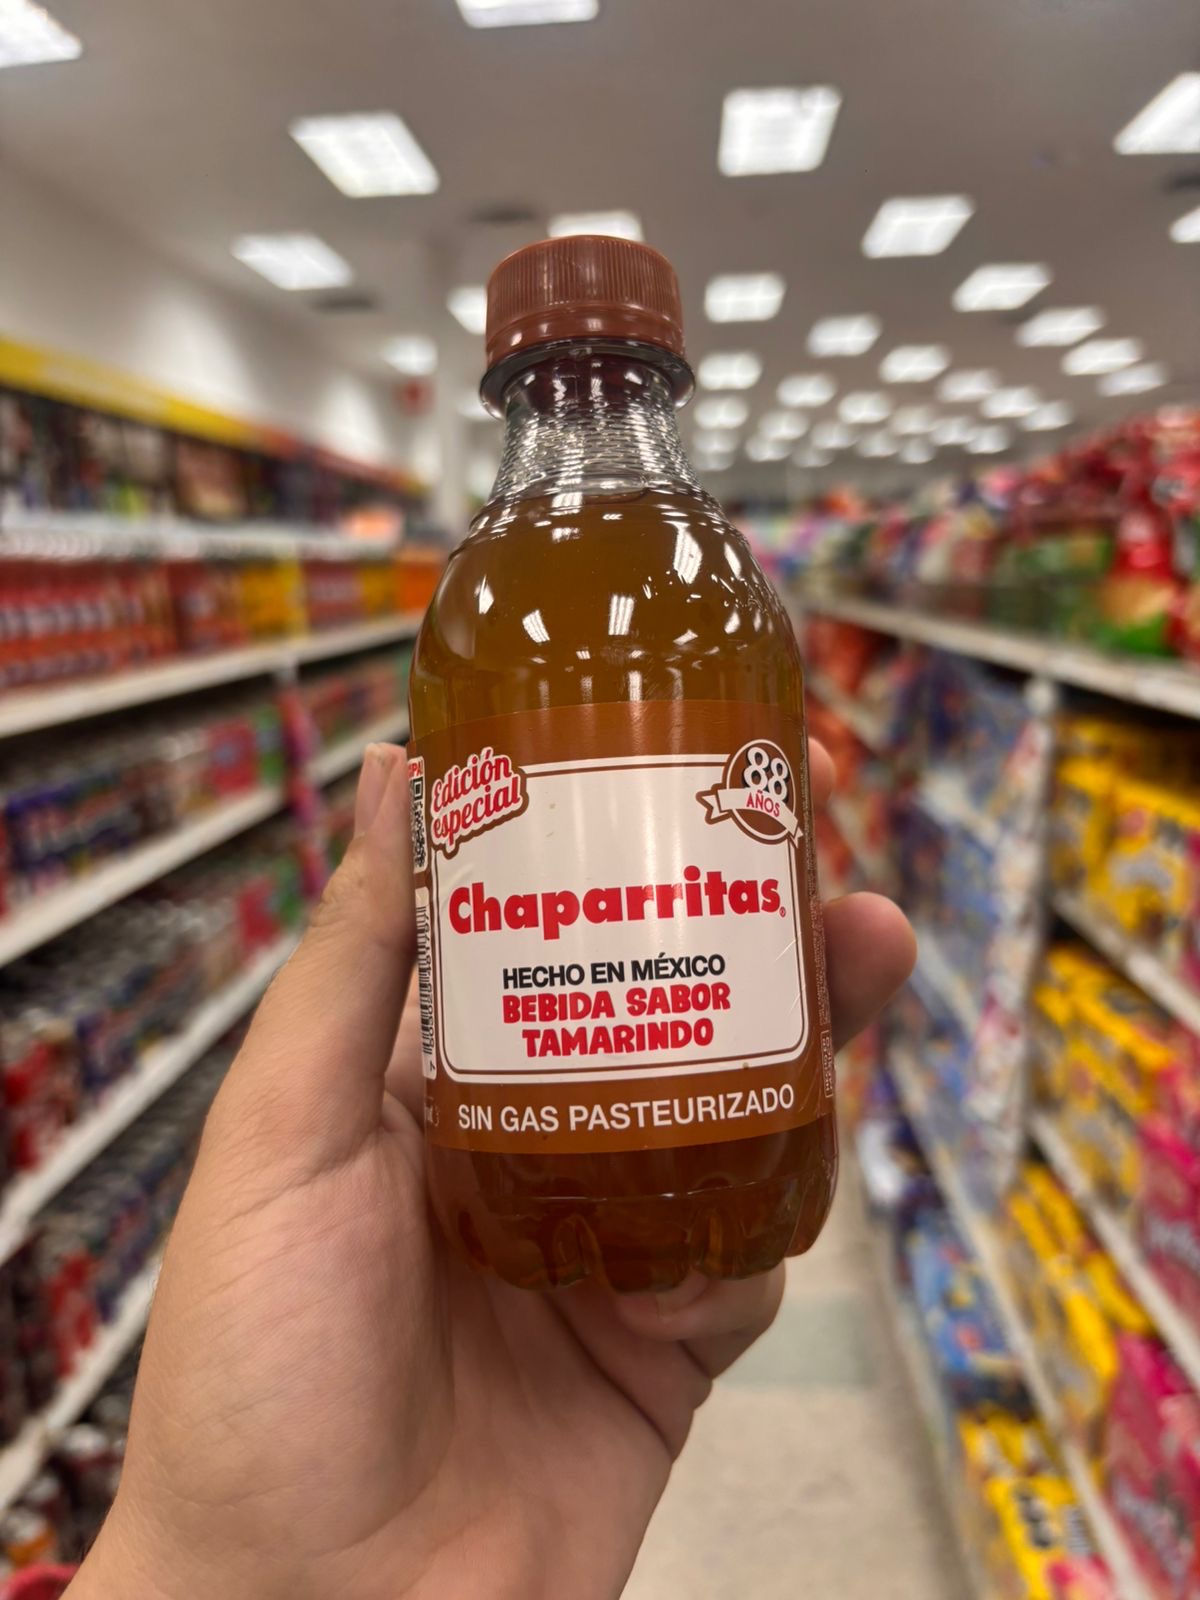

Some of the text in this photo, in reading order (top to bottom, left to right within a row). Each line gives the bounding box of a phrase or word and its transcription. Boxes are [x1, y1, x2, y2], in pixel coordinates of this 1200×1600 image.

[434, 749, 512, 812] Edición
[743, 746, 788, 801] 88
[433, 776, 521, 846] especial
[746, 789, 780, 817] AÑOS
[448, 865, 781, 941] Chaparritas
[502, 952, 726, 989] HECHO EN MÉXICO
[502, 982, 731, 1023] BEBIDA SABOR
[522, 1018, 714, 1058] TAMARINDO
[458, 1104, 493, 1131] SIN
[500, 1105, 559, 1132] GAS
[570, 1083, 794, 1131] PASTEURIZADO
